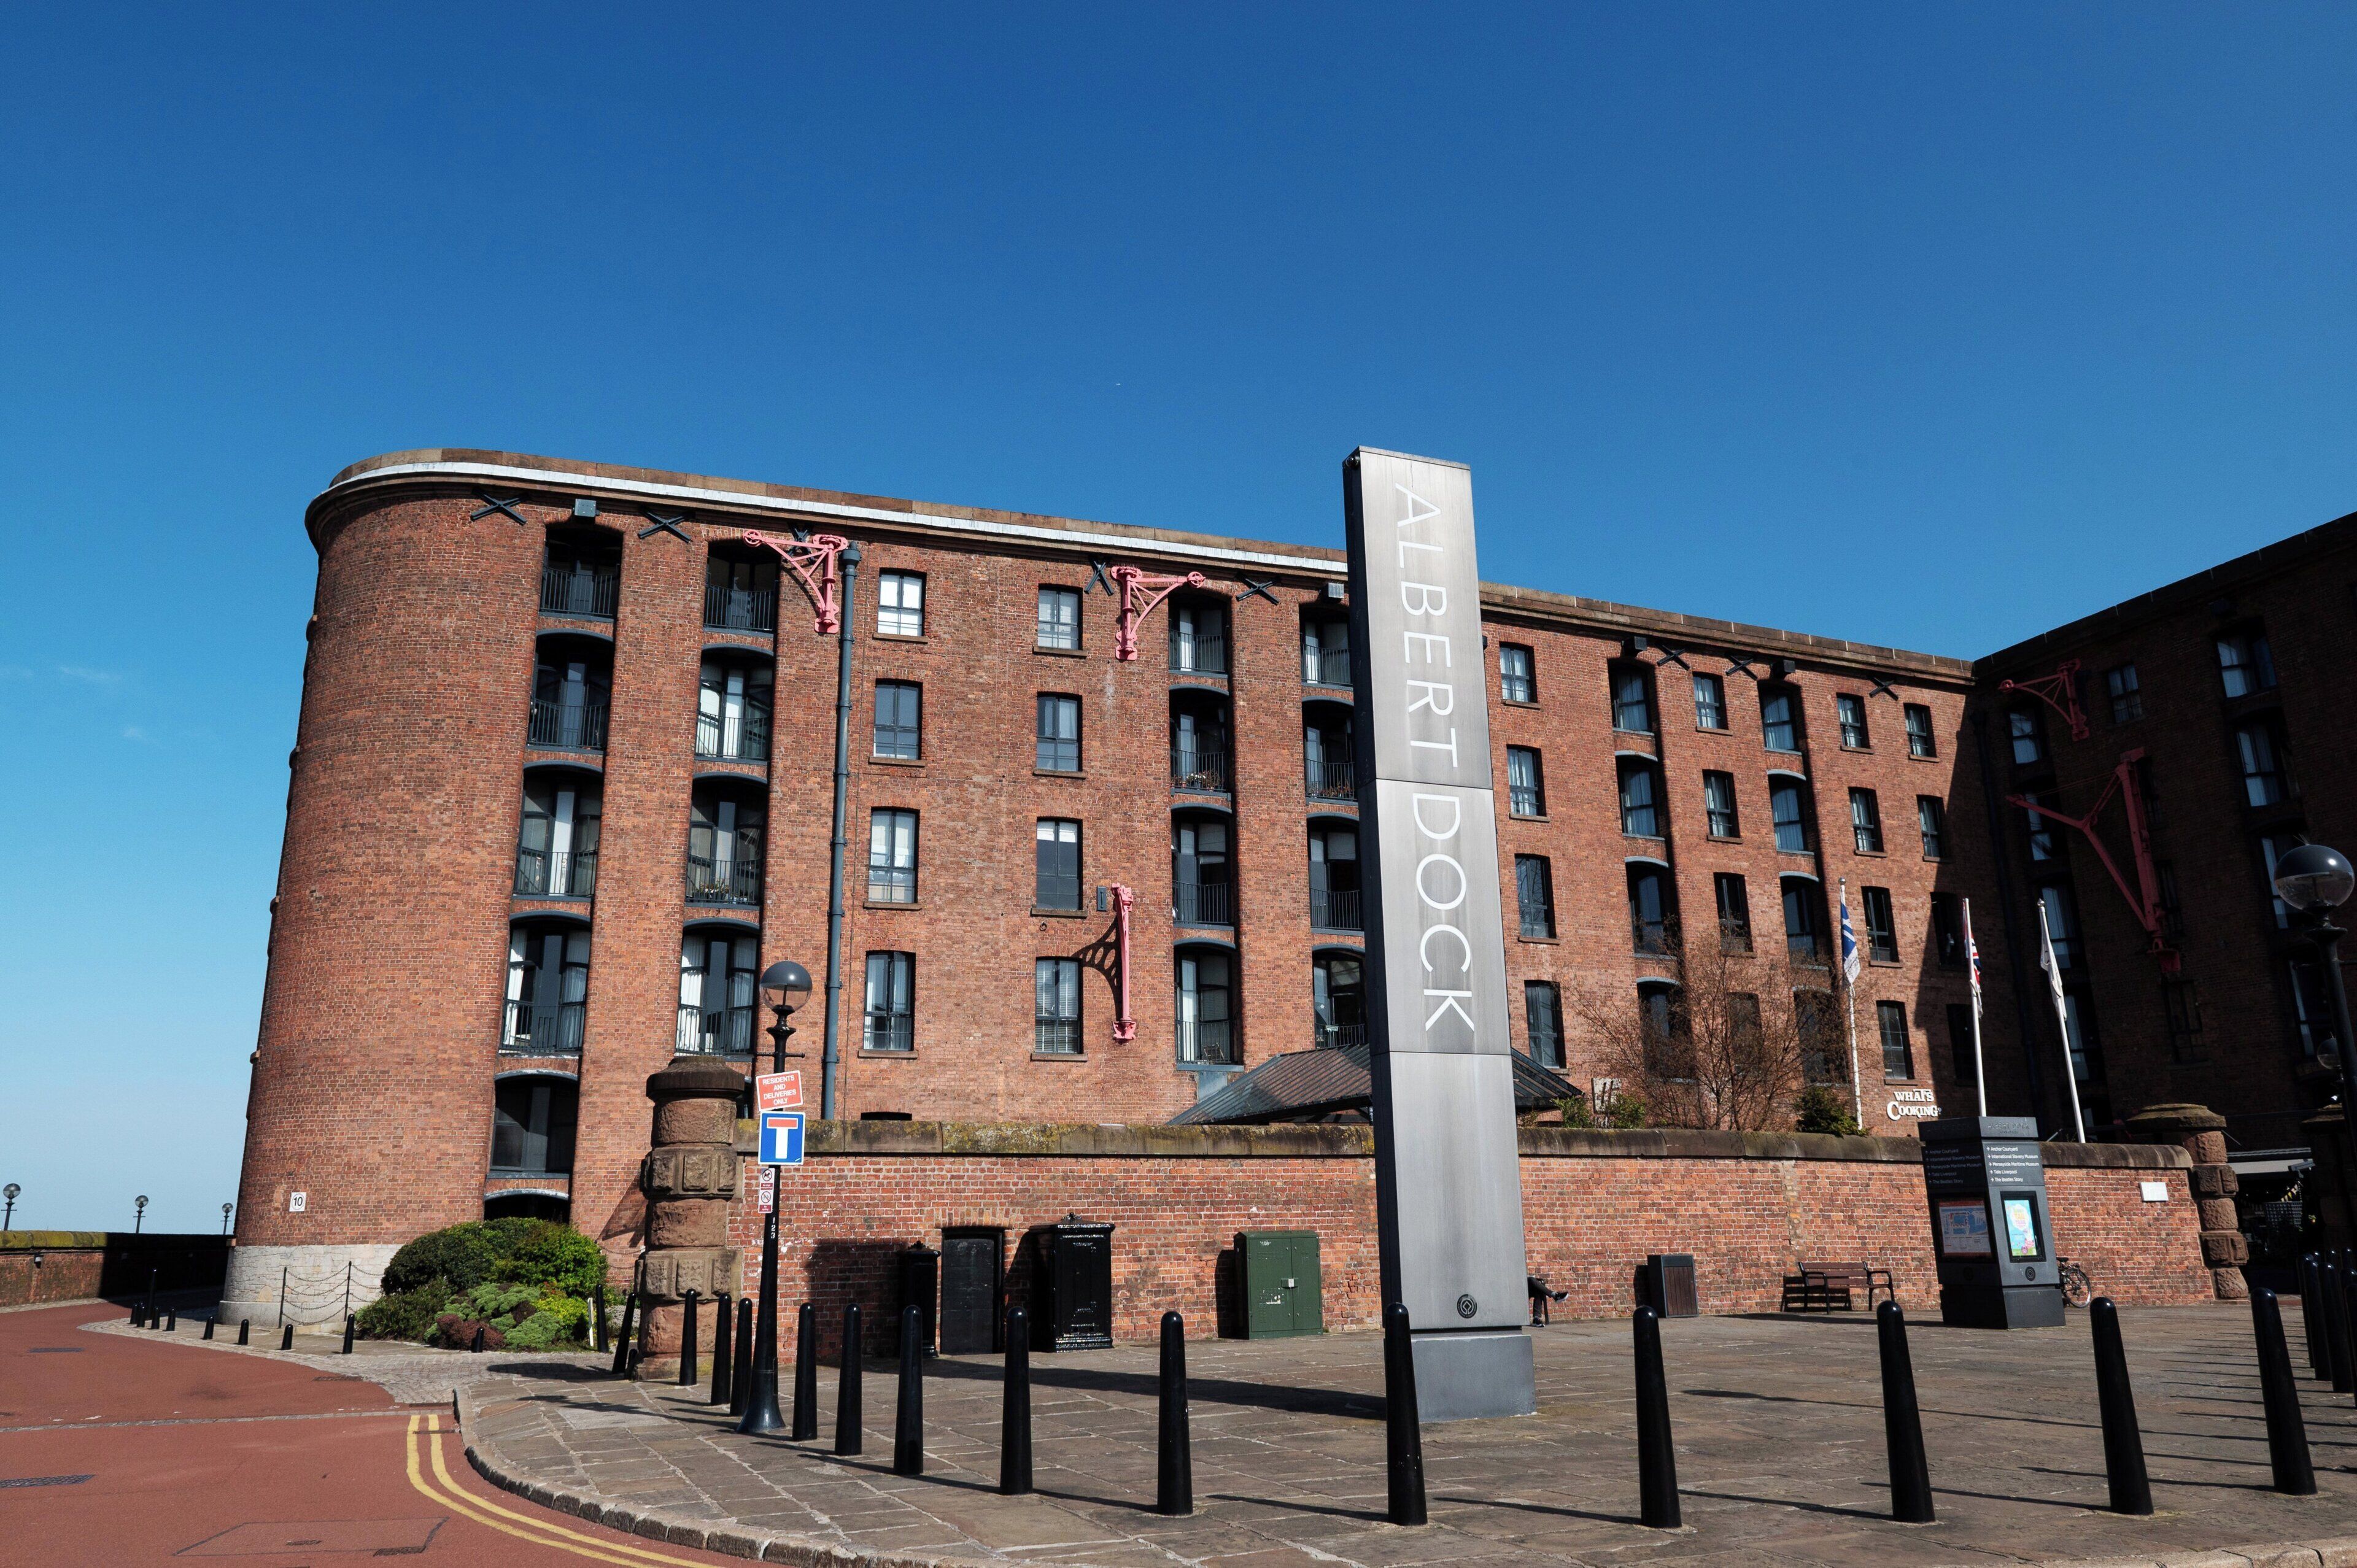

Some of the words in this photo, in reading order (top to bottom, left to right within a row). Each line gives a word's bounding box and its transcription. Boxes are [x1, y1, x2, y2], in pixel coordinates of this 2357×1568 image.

[1395, 482, 1458, 768] ALBERT
[1412, 793, 1475, 1032] DOCK
[762, 1075, 795, 1085] RESIDENTS
[763, 1089, 797, 1100] DELIVERIES
[1894, 1089, 1935, 1102] WHAT'S
[293, 1197, 303, 1207] 10
